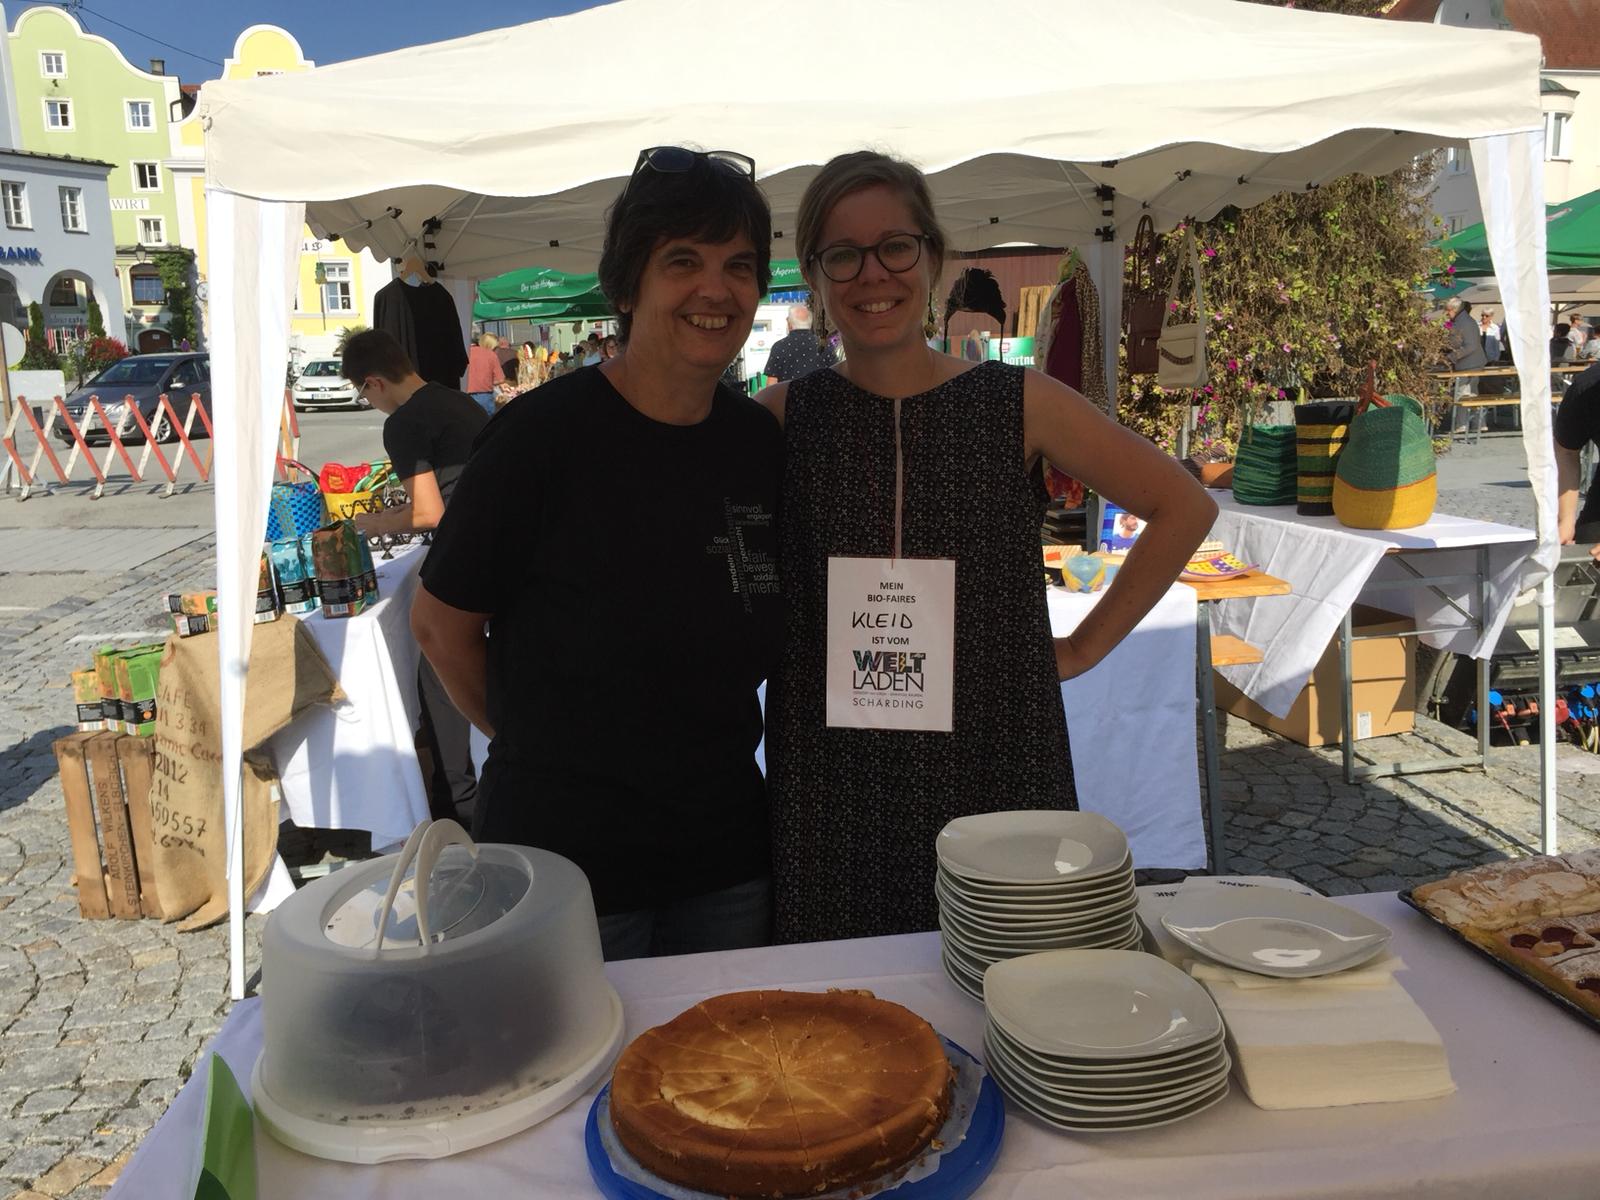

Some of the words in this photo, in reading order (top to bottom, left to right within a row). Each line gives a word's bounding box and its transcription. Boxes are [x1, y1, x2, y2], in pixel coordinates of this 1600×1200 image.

[111, 199, 145, 210] WIRT
[727, 553, 740, 593] handeln
[879, 582, 904, 591] MEIN
[867, 594, 916, 604] BIO-FAIRES
[852, 611, 913, 629] KLEID
[871, 636, 885, 645] IST
[886, 636, 909, 645] VOM
[852, 650, 926, 673] WELT
[852, 670, 925, 693] LADEN
[98, 782, 113, 833] WILKENS
[106, 842, 121, 880] ADOLF
